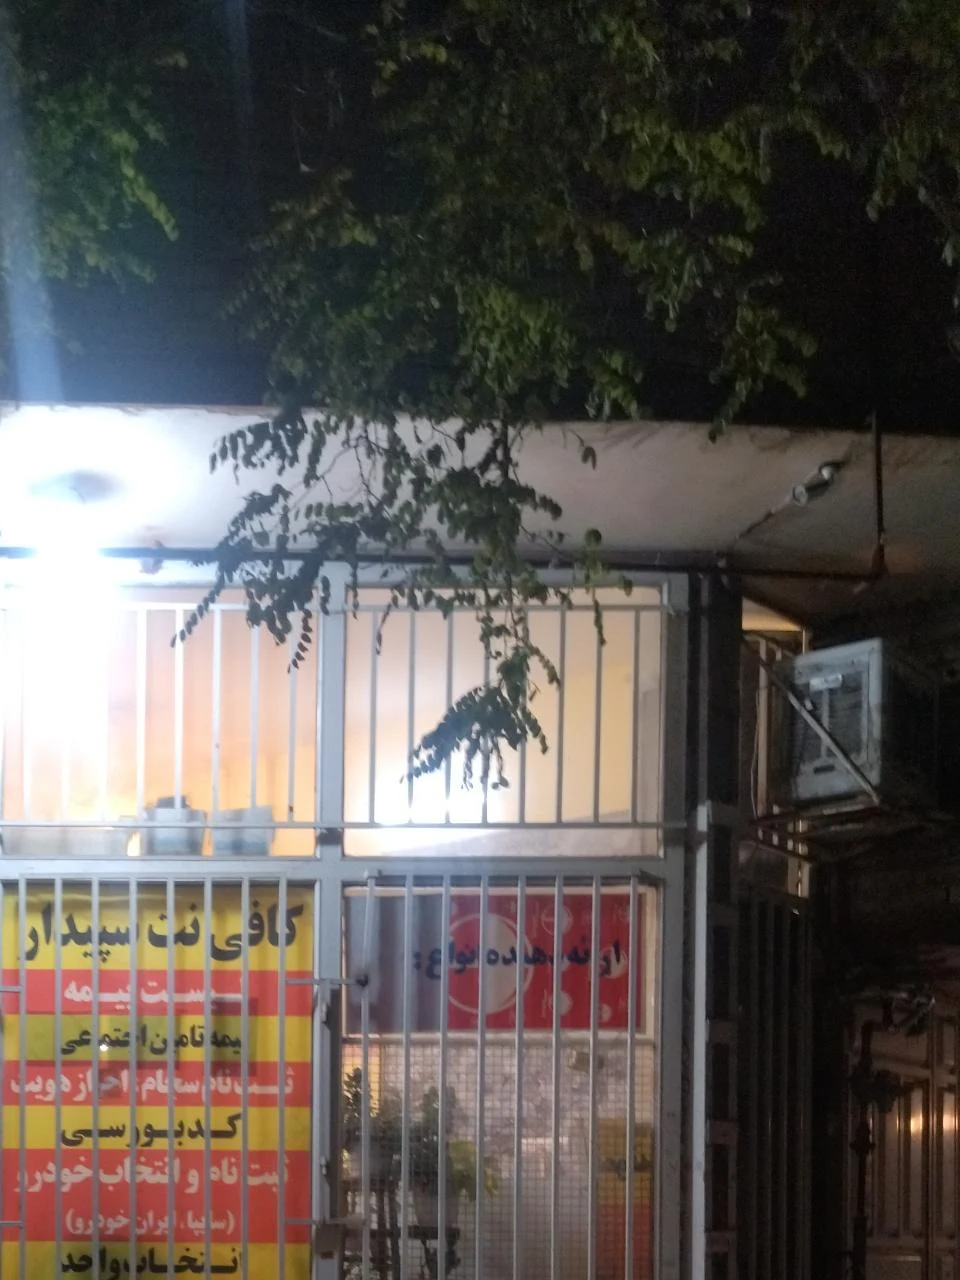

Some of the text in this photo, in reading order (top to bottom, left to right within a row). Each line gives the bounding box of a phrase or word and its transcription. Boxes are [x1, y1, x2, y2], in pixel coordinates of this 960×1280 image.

[18, 900, 304, 963] کافی نت سپیدار
[98, 1157, 181, 1192] انتخاب
[184, 1165, 200, 1194] و
[209, 1157, 239, 1187] نام
